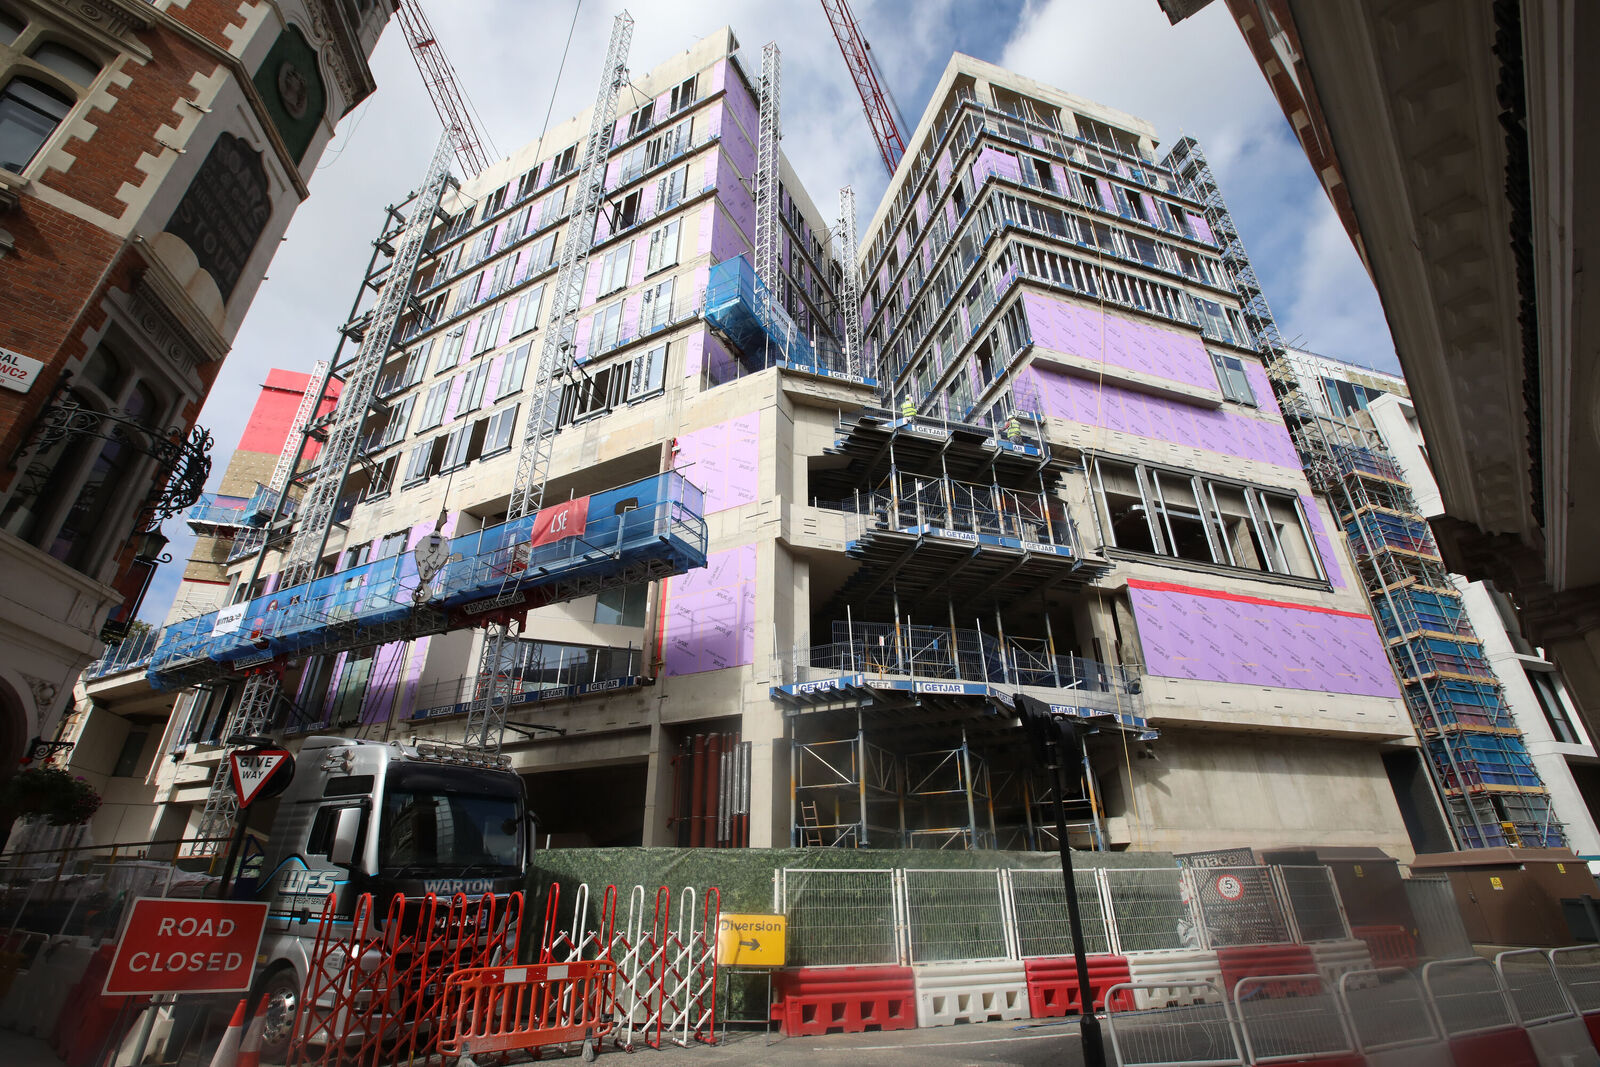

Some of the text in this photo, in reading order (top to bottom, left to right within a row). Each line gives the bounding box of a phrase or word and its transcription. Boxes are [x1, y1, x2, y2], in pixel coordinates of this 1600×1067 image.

[180, 198, 239, 285] STOUT
[551, 510, 568, 533] LSE
[946, 530, 976, 541] GETJAR
[1026, 542, 1055, 553] GETJAR
[592, 682, 617, 691] GETAR
[800, 680, 836, 692] GETJAR
[924, 683, 961, 693] GETJAR
[1051, 706, 1074, 714] ETJAR
[240, 757, 273, 768] GIVE
[242, 771, 264, 779] WAY
[1193, 855, 1237, 867] mace
[279, 871, 340, 894] WFS
[424, 880, 494, 893] WARTON
[1224, 880, 1233, 889] 5
[157, 918, 236, 936] ROAD
[720, 919, 781, 932] Diversion
[129, 952, 242, 972] CLOSED
